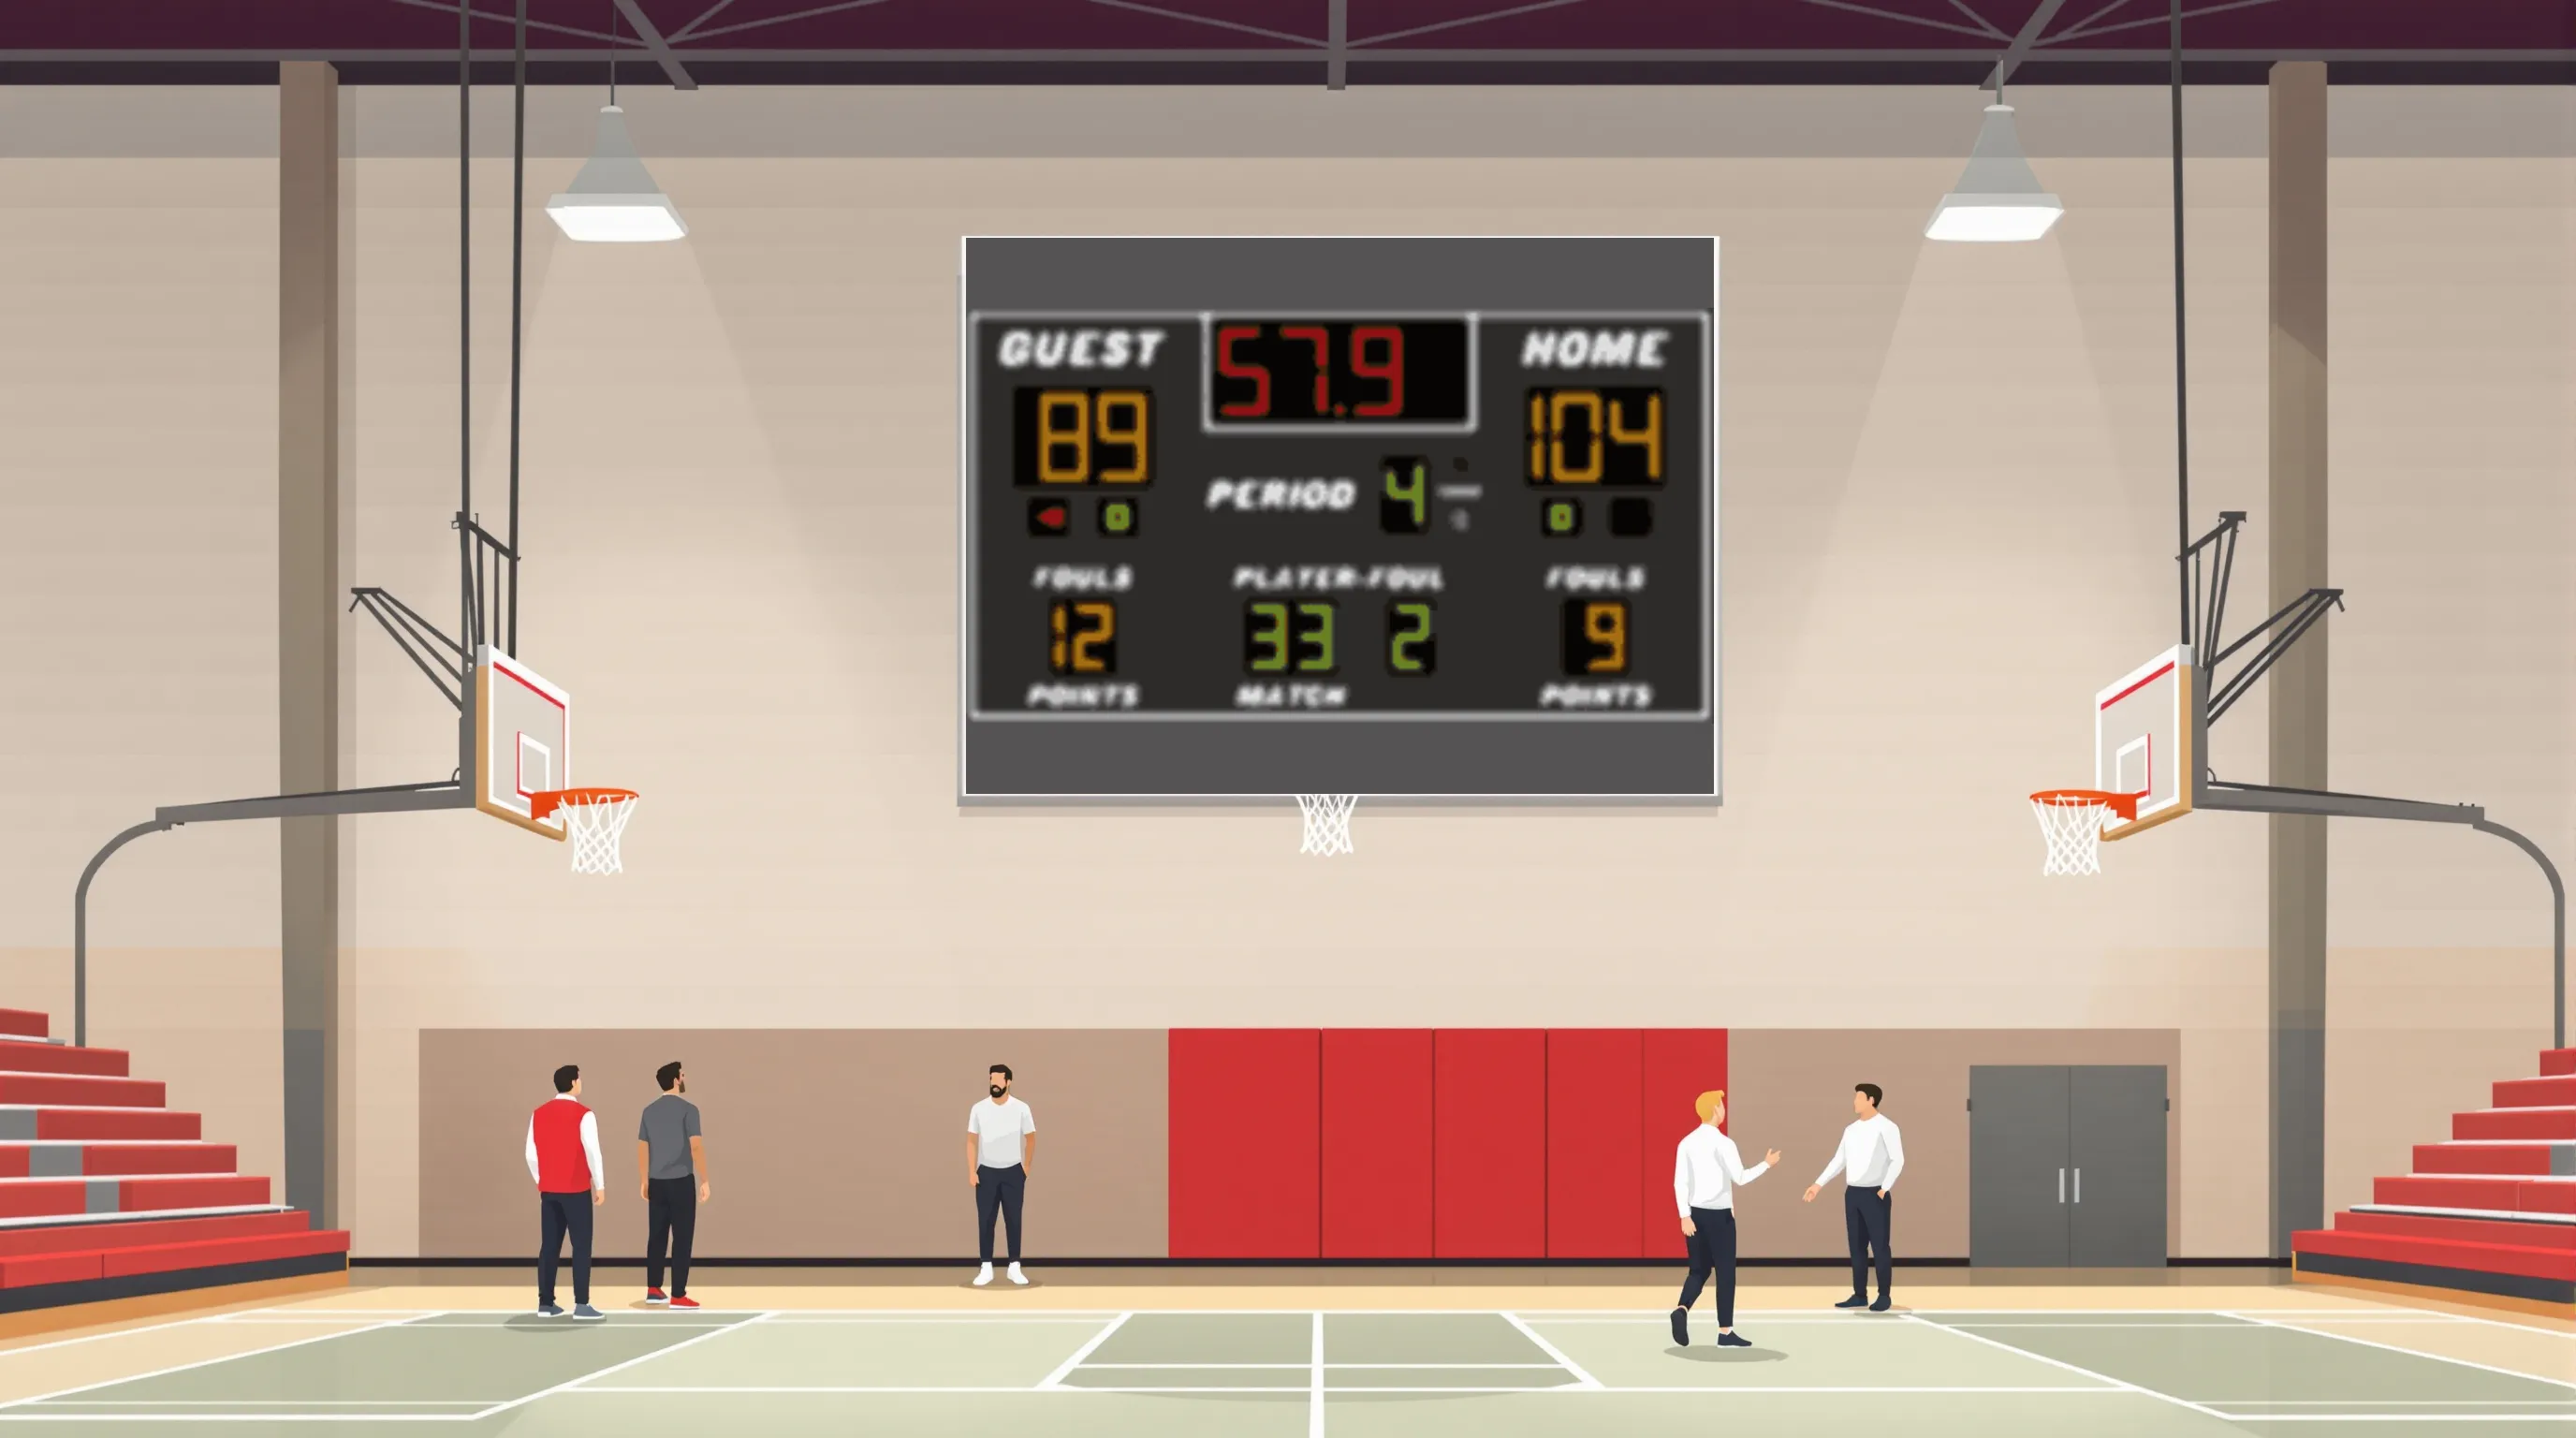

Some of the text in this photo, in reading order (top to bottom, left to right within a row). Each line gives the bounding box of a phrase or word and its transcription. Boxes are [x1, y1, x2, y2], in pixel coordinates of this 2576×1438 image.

[997, 329, 1166, 369] GUEST
[1219, 327, 1403, 417] 57.9
[1038, 391, 1148, 483] 89
[1531, 391, 1661, 483] 104
[1206, 478, 1357, 511] PERIOD
[1386, 466, 1425, 522] 4
[1051, 602, 1114, 671] 12
[1252, 604, 1333, 669] 33
[1392, 604, 1430, 669] 2
[1586, 603, 1626, 671] 9
